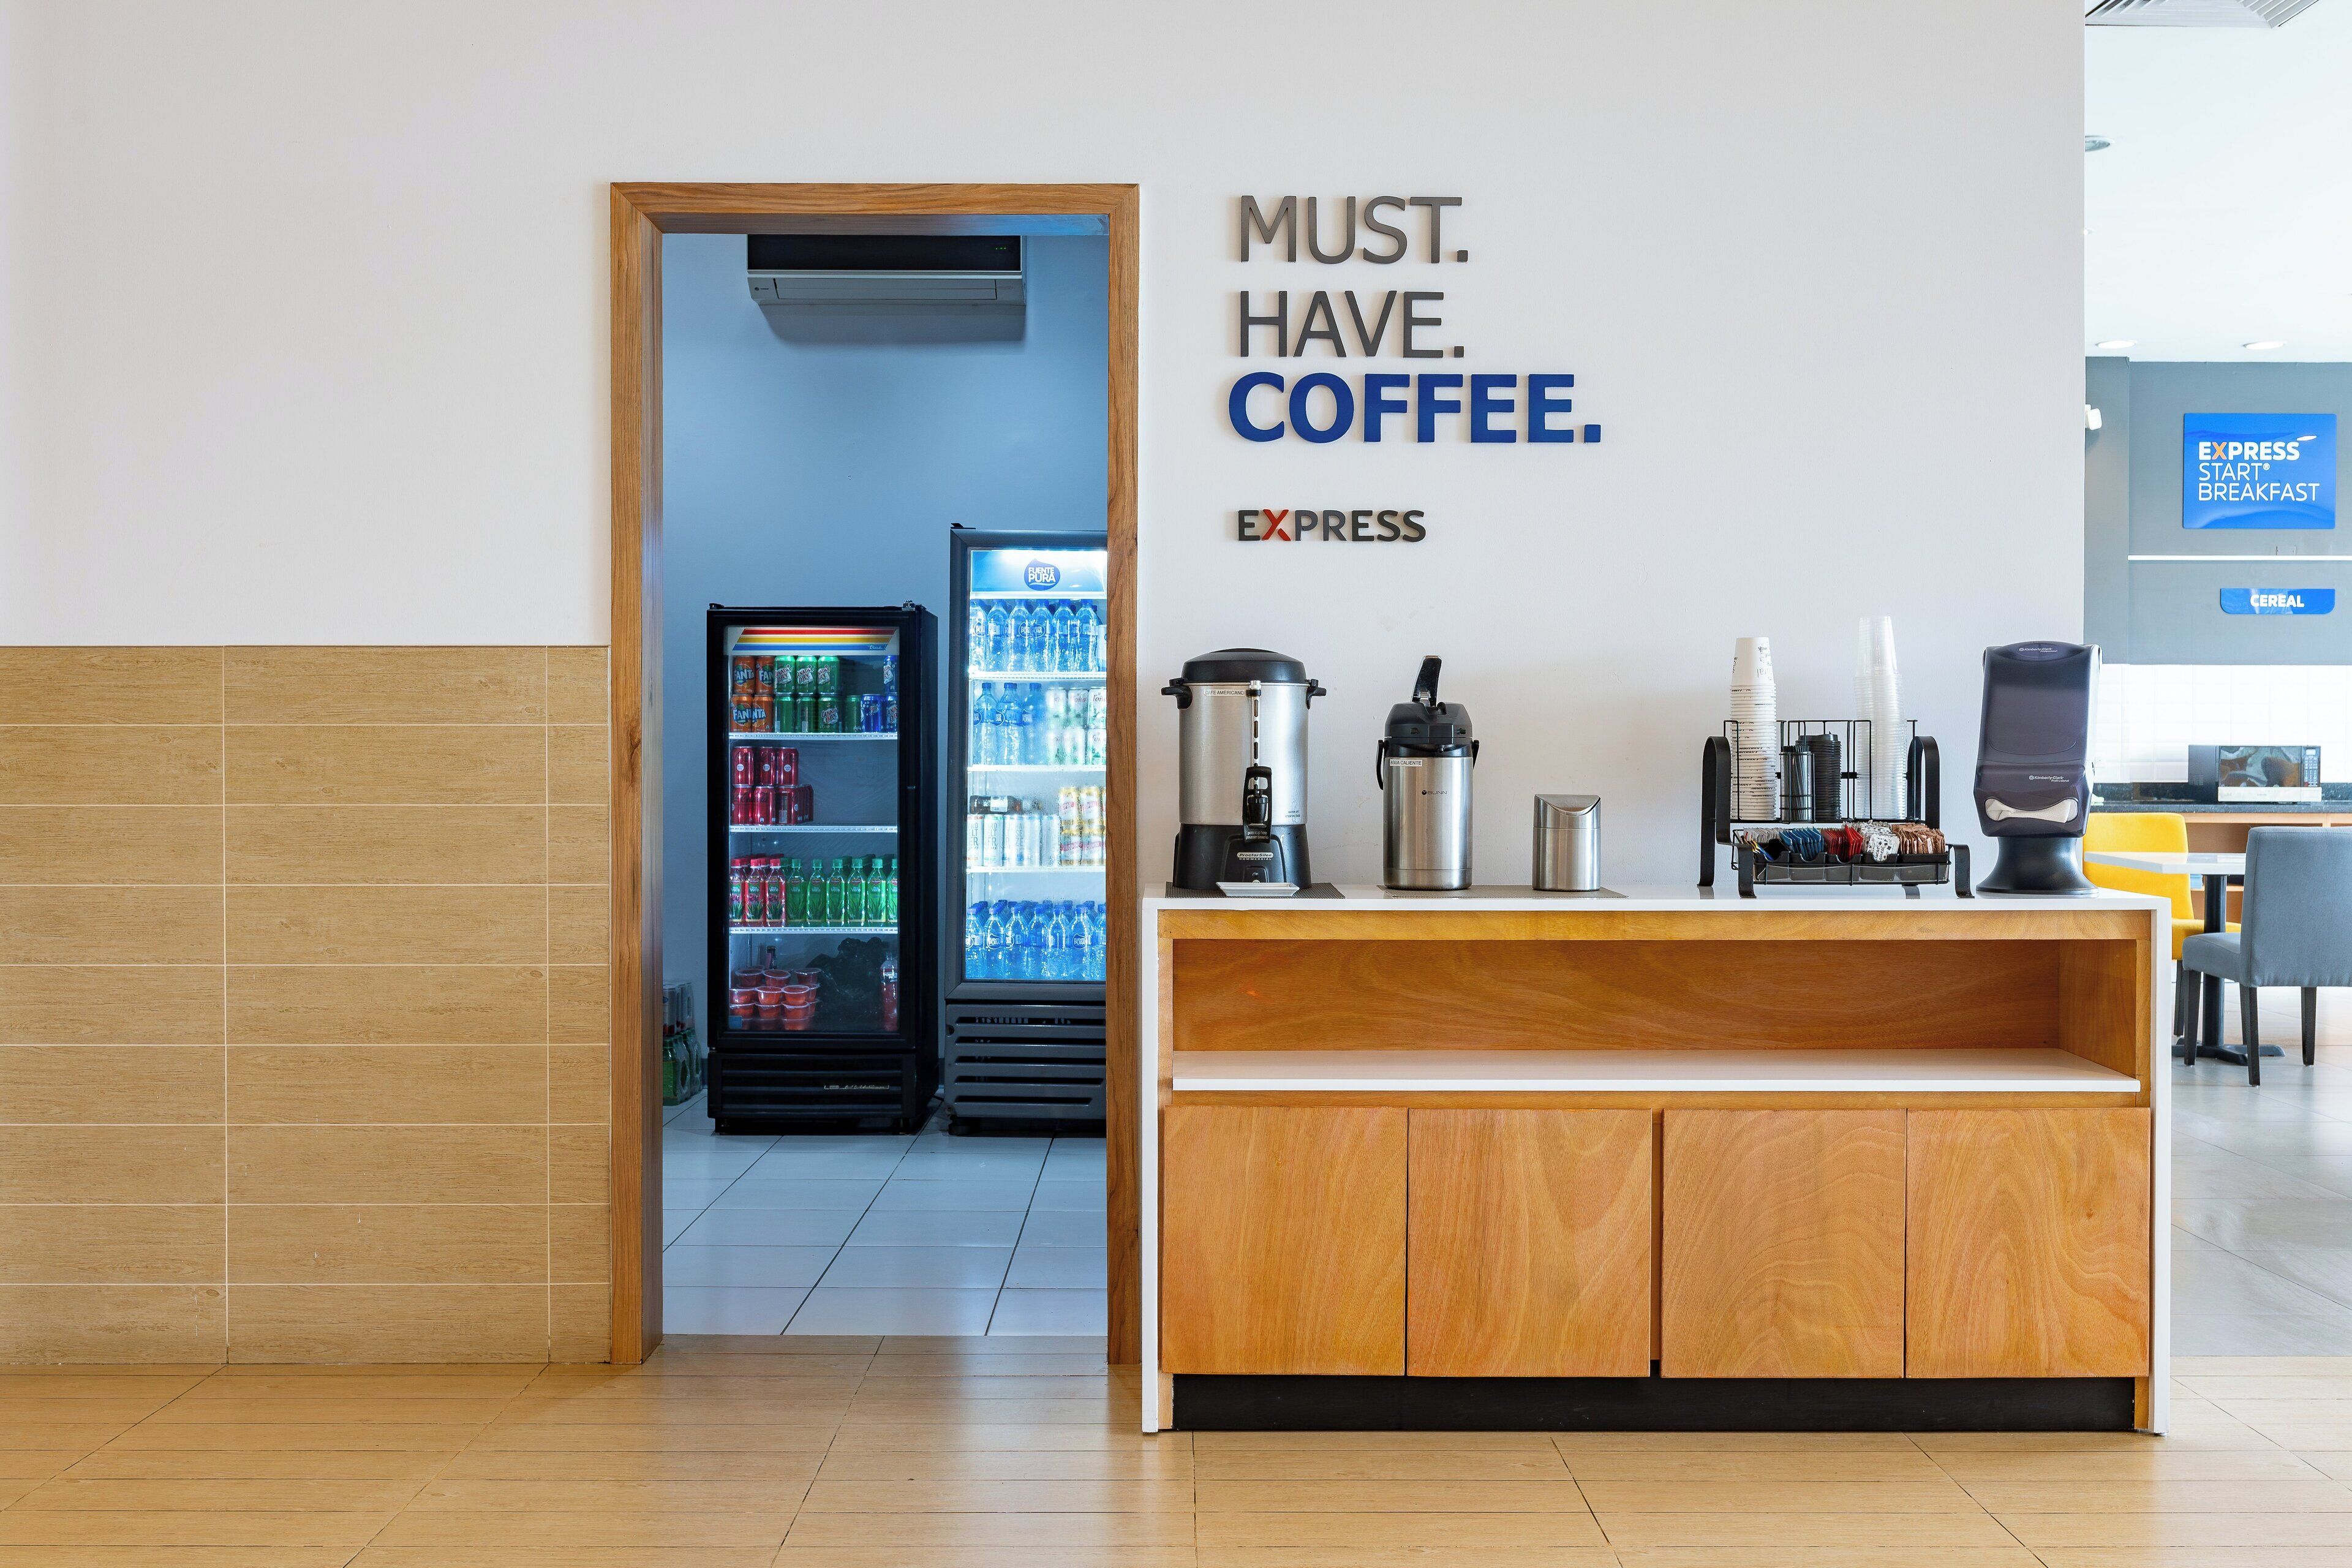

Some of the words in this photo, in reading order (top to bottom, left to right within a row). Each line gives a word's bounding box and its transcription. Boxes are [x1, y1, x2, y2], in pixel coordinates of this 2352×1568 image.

[1240, 195, 1469, 264] MUST.
[1240, 290, 1465, 358] HAVE.
[1229, 372, 1601, 443] COFFEE.
[2198, 442, 2300, 461] EXPRESS
[2198, 483, 2320, 501] BREAKFAST
[1237, 509, 1427, 542] EXPRESS
[1028, 573, 1056, 582] PURA
[2250, 594, 2305, 608] CEREAL
